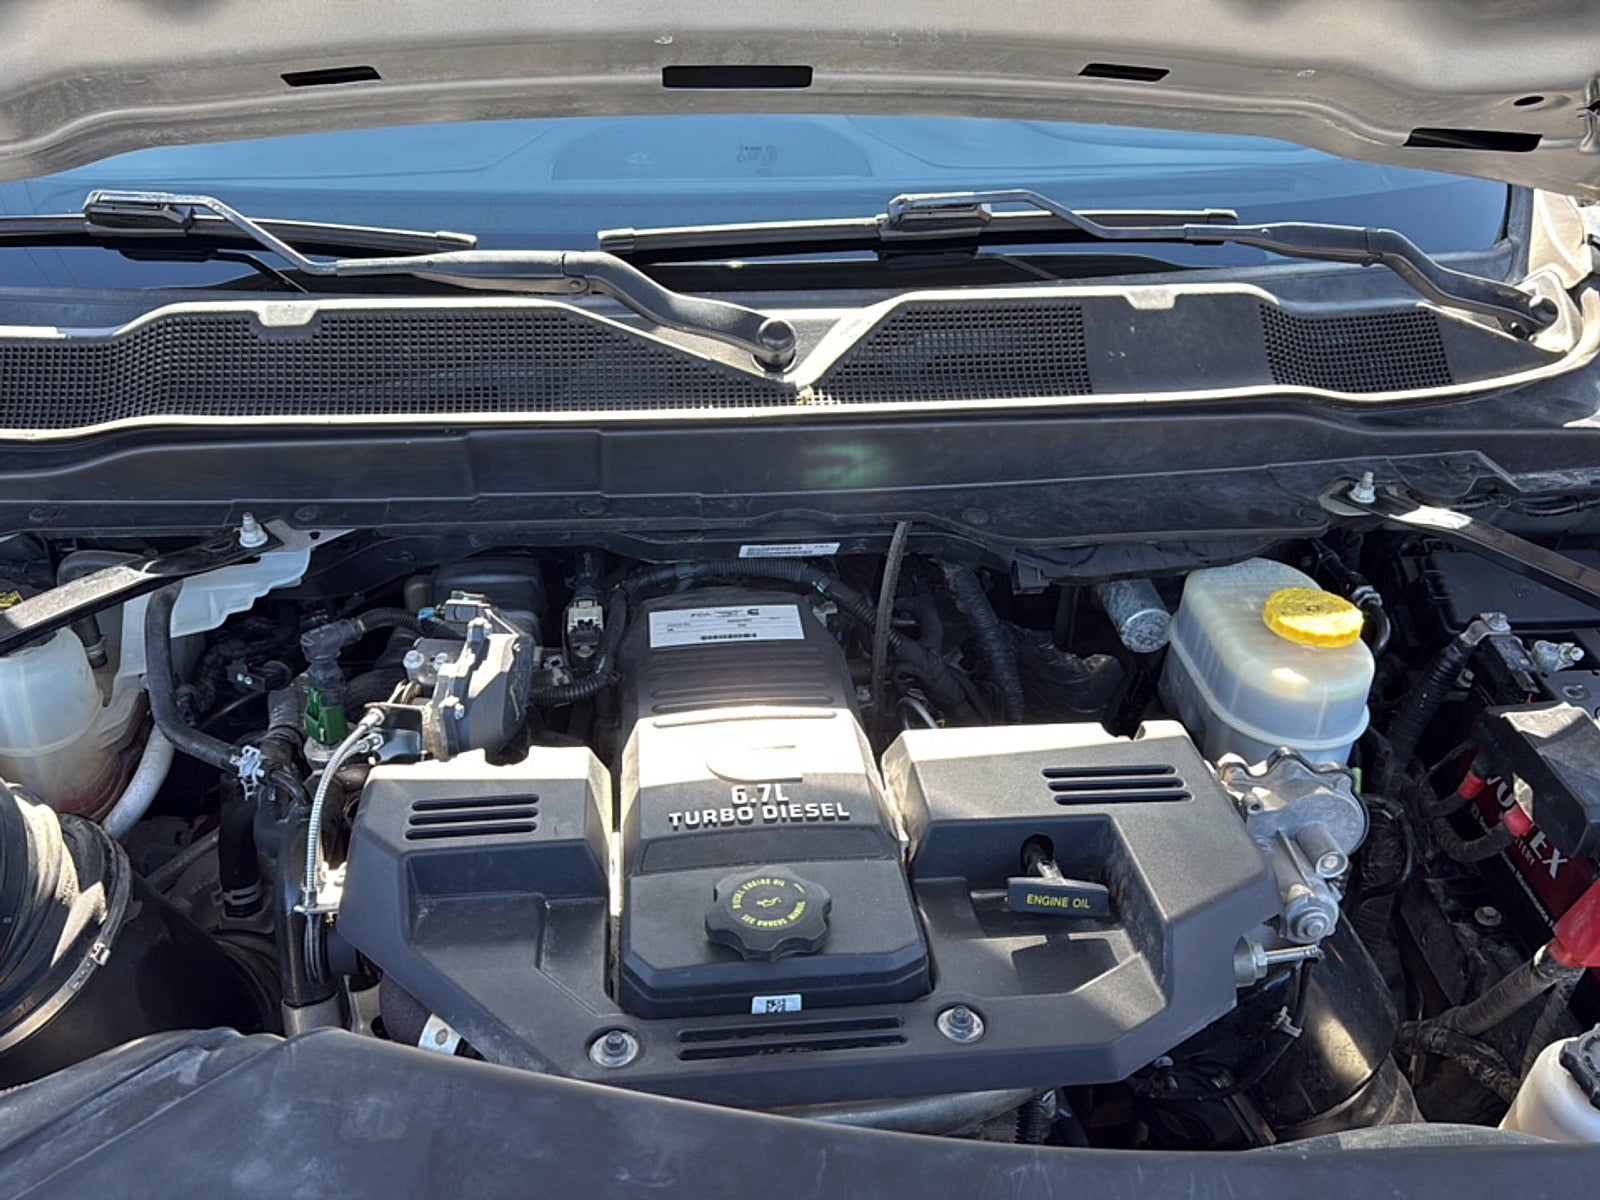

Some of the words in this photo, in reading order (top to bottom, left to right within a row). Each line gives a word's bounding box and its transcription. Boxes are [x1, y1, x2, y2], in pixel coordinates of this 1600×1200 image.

[731, 784, 789, 804] 6.7L
[668, 806, 753, 828] TURBO
[762, 802, 850, 820] DIESEL
[1026, 893, 1069, 908] ENGINE
[1072, 898, 1091, 909] OIL
